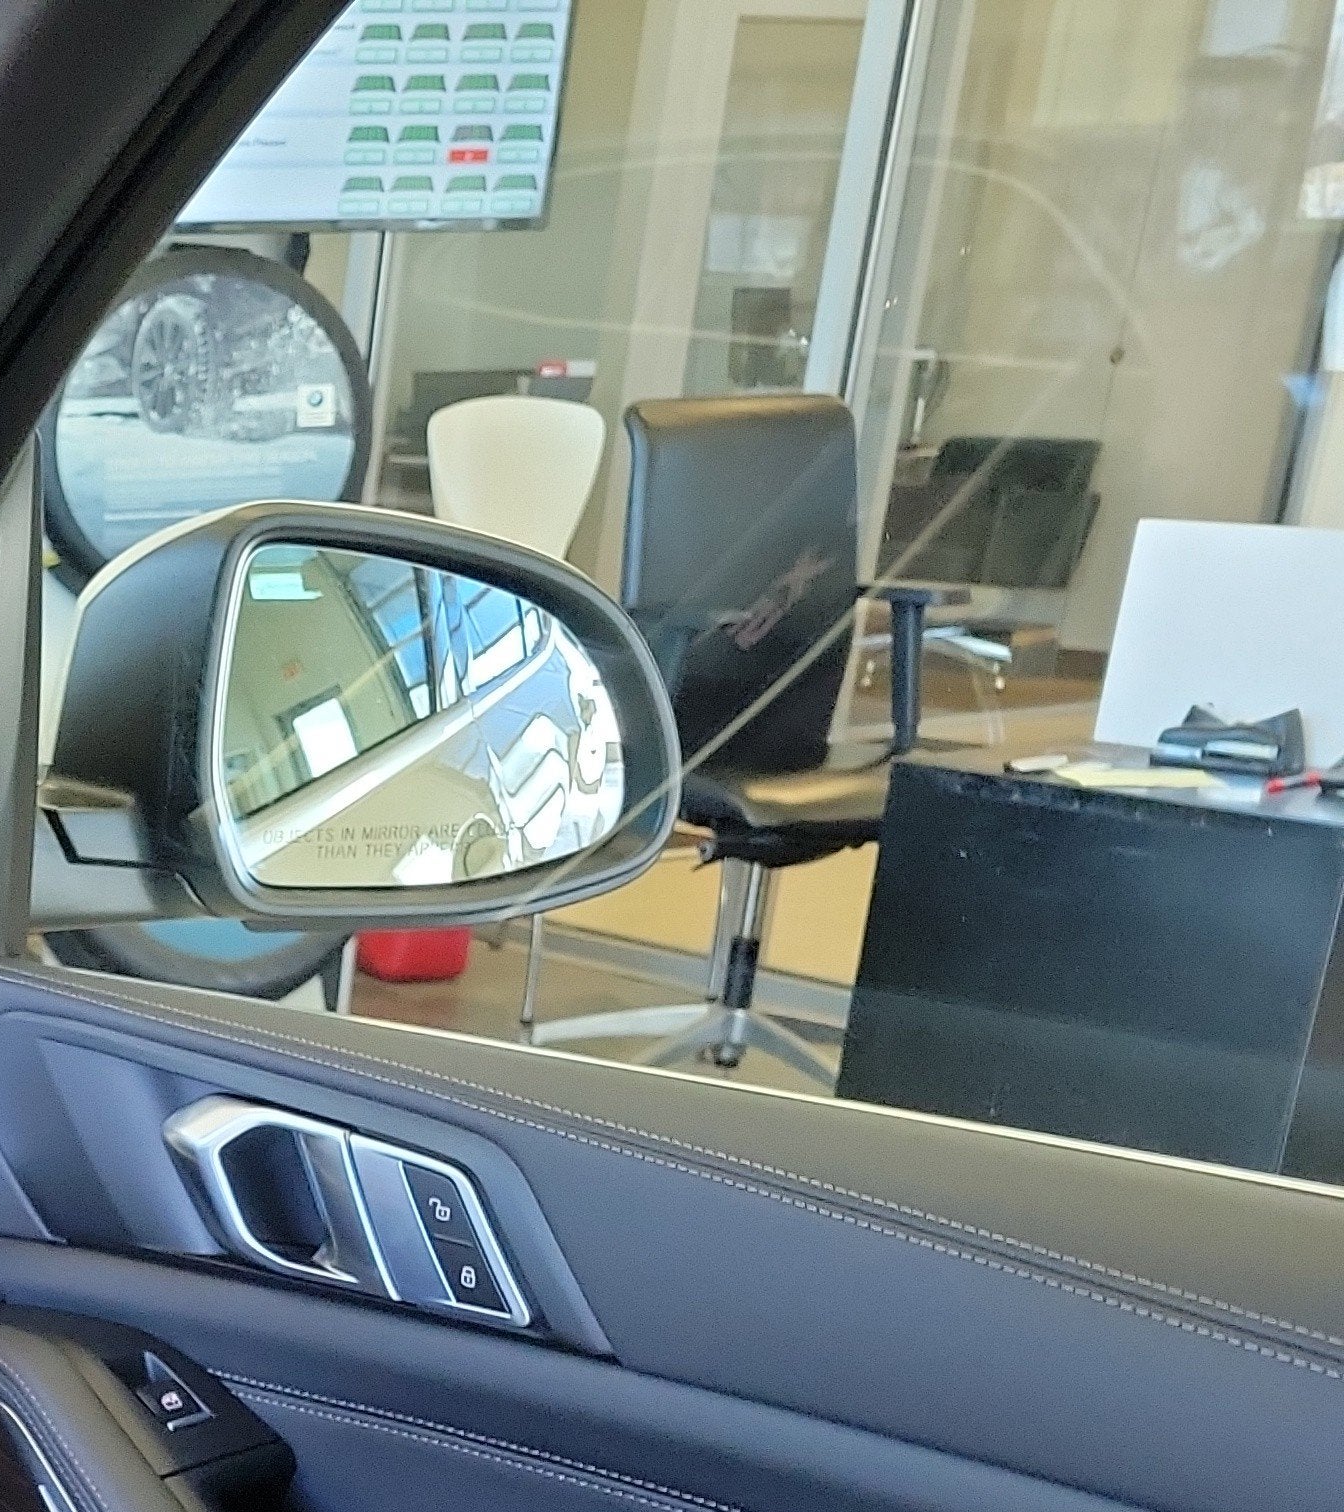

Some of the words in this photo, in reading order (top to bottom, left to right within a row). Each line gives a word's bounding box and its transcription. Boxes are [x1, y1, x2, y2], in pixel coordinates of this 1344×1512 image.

[341, 827, 355, 842] IN
[362, 825, 420, 842] MIRROR
[427, 822, 460, 838] ARE
[316, 844, 358, 860] THAN
[365, 842, 403, 859] THEY
